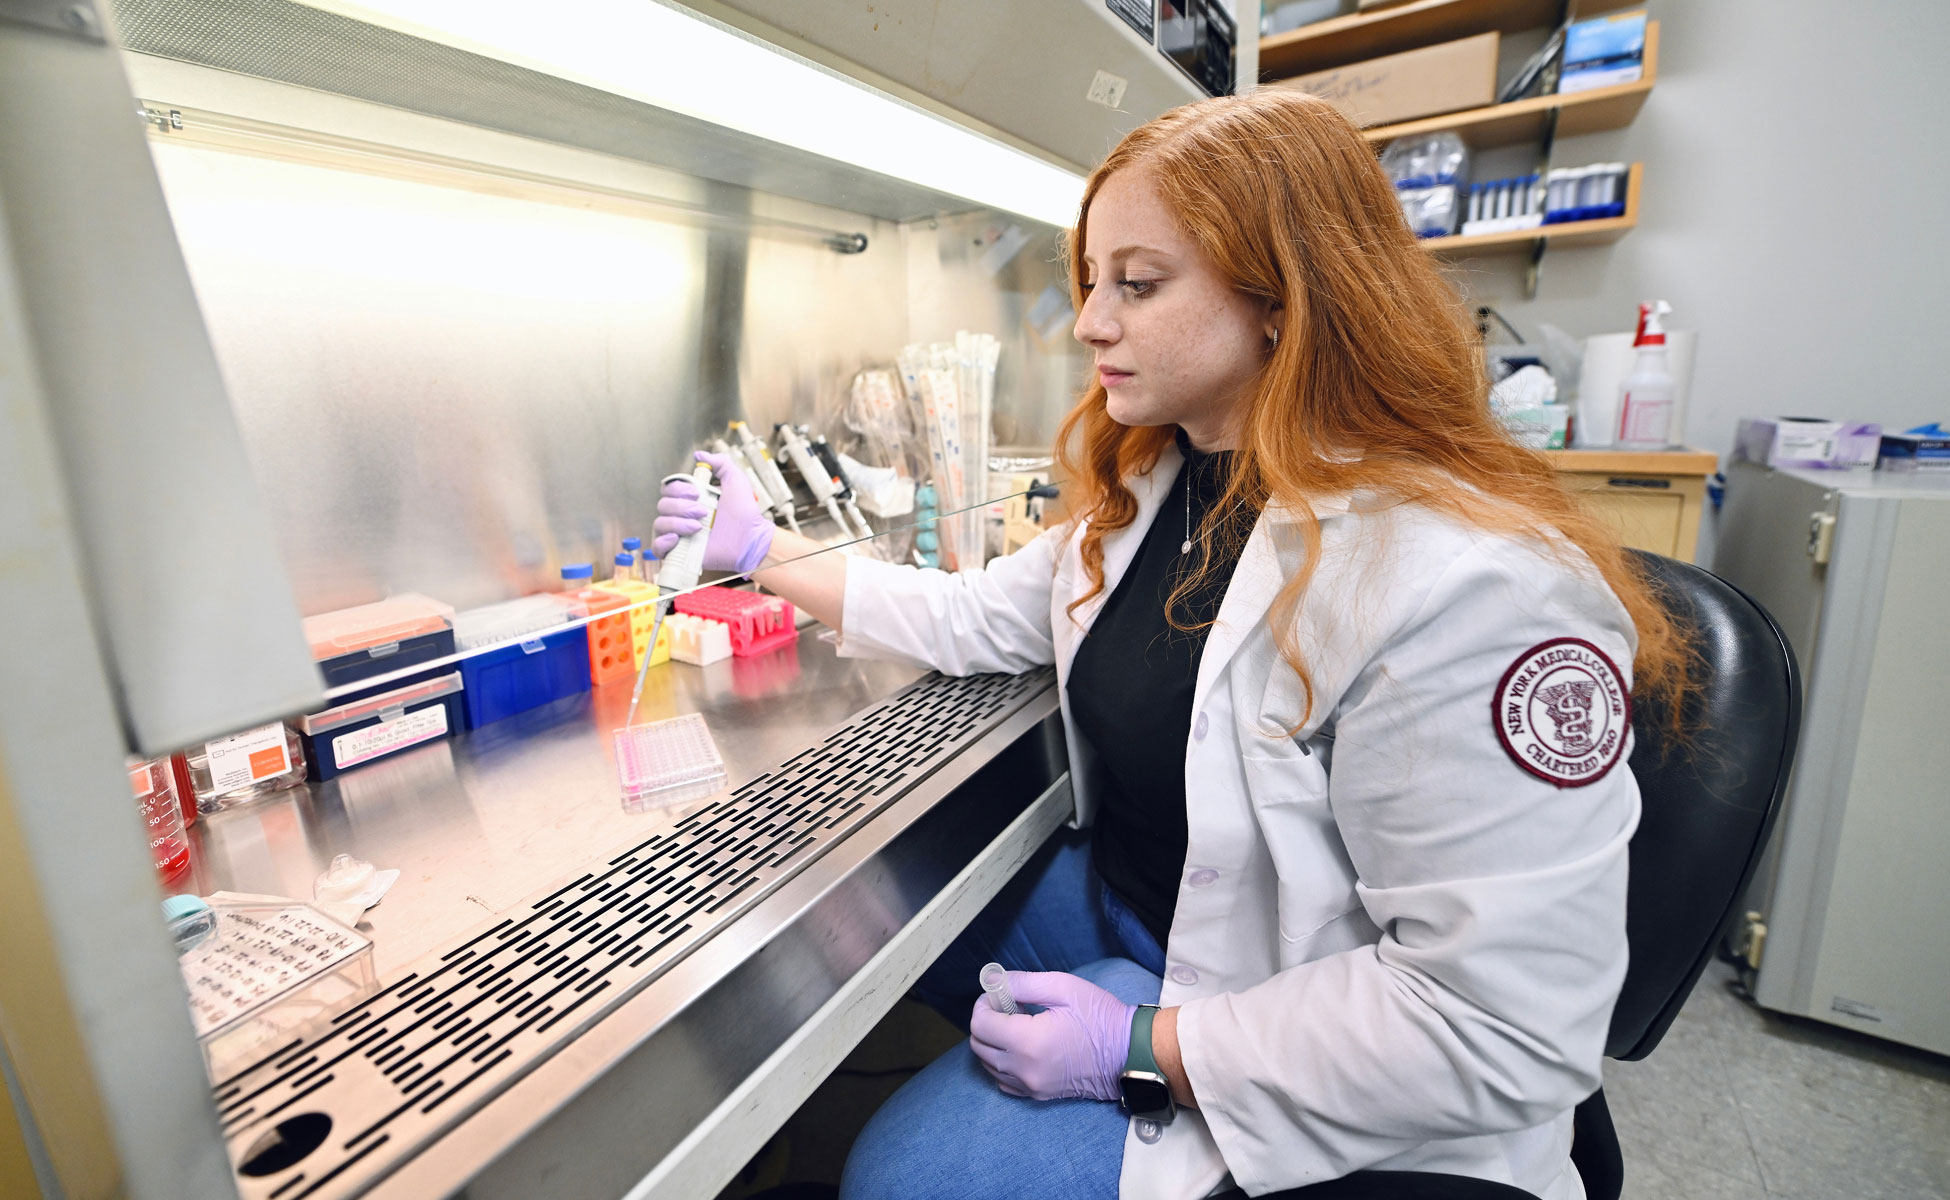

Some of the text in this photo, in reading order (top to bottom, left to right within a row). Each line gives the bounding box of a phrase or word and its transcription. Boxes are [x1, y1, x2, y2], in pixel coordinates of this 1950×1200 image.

[1507, 648, 1623, 736] NEW YORK MEDICAL COLLEGE
[1525, 729, 1618, 776] CHARTERED 1860
[149, 816, 160, 826] 50
[150, 837, 164, 849] 100
[155, 858, 170, 869] 150
